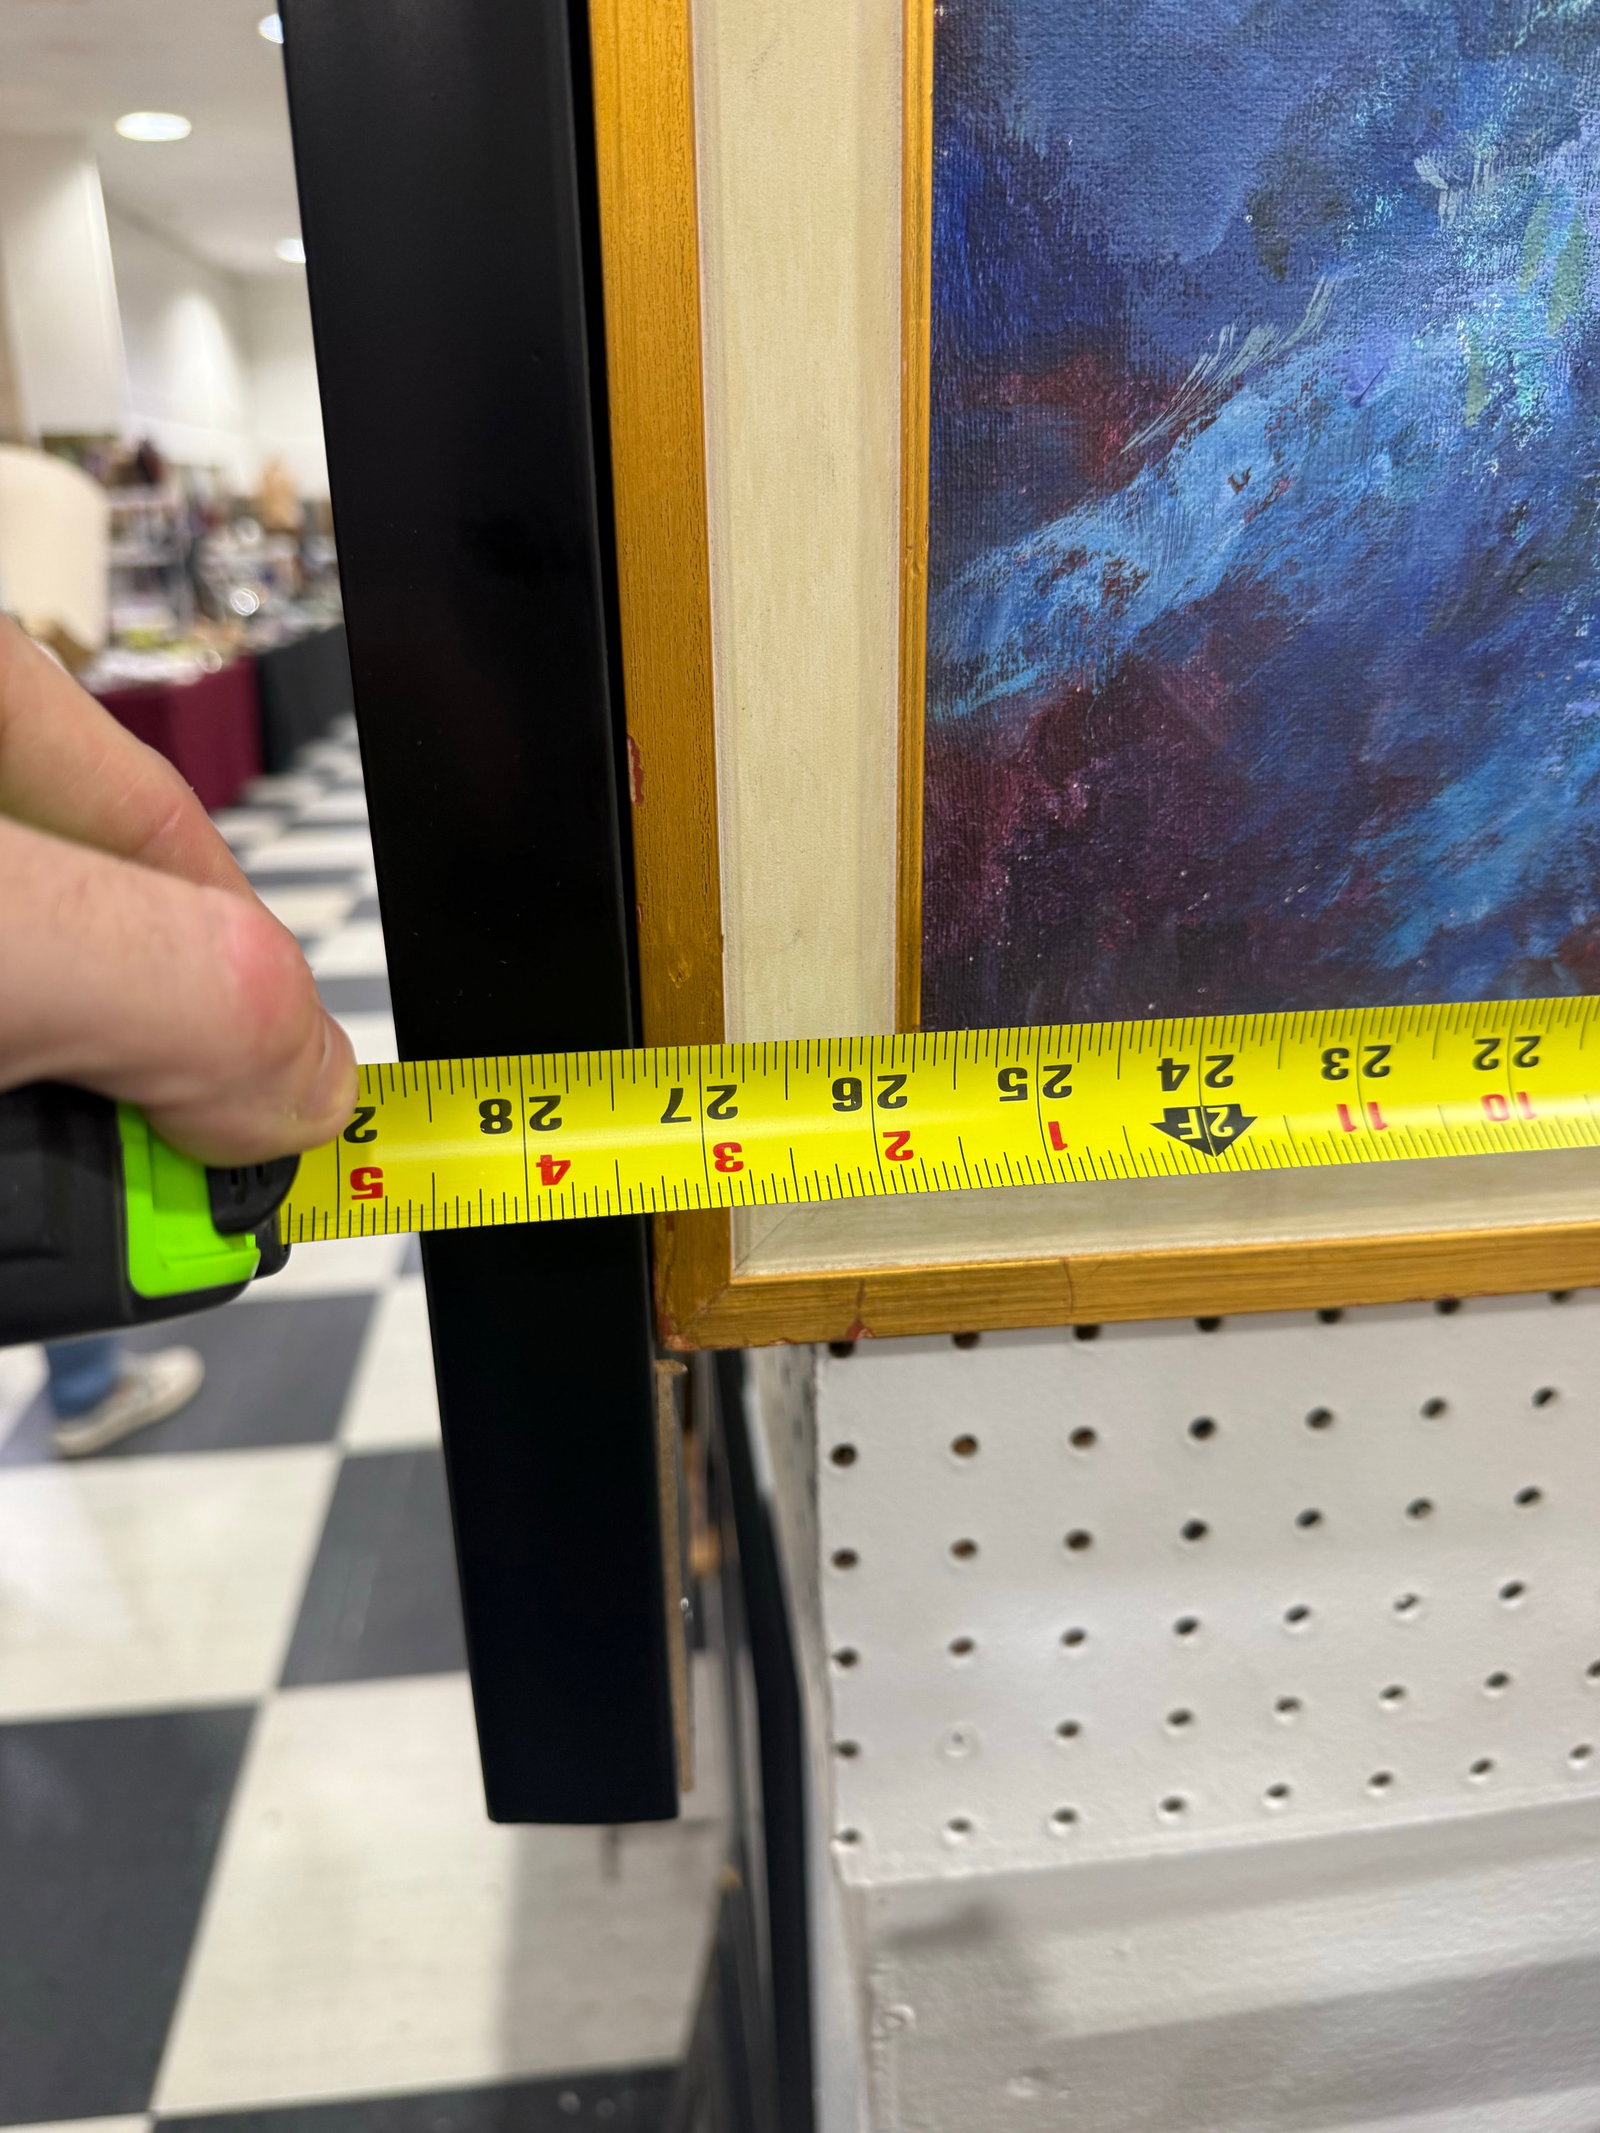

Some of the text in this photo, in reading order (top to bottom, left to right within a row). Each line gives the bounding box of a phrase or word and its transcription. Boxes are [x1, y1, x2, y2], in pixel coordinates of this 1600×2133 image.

[343, 1035, 1541, 1143] 22 23 24 25 26 27 28 2
[349, 1091, 1537, 1200] 10 11 2F 1 2 3 4 5
